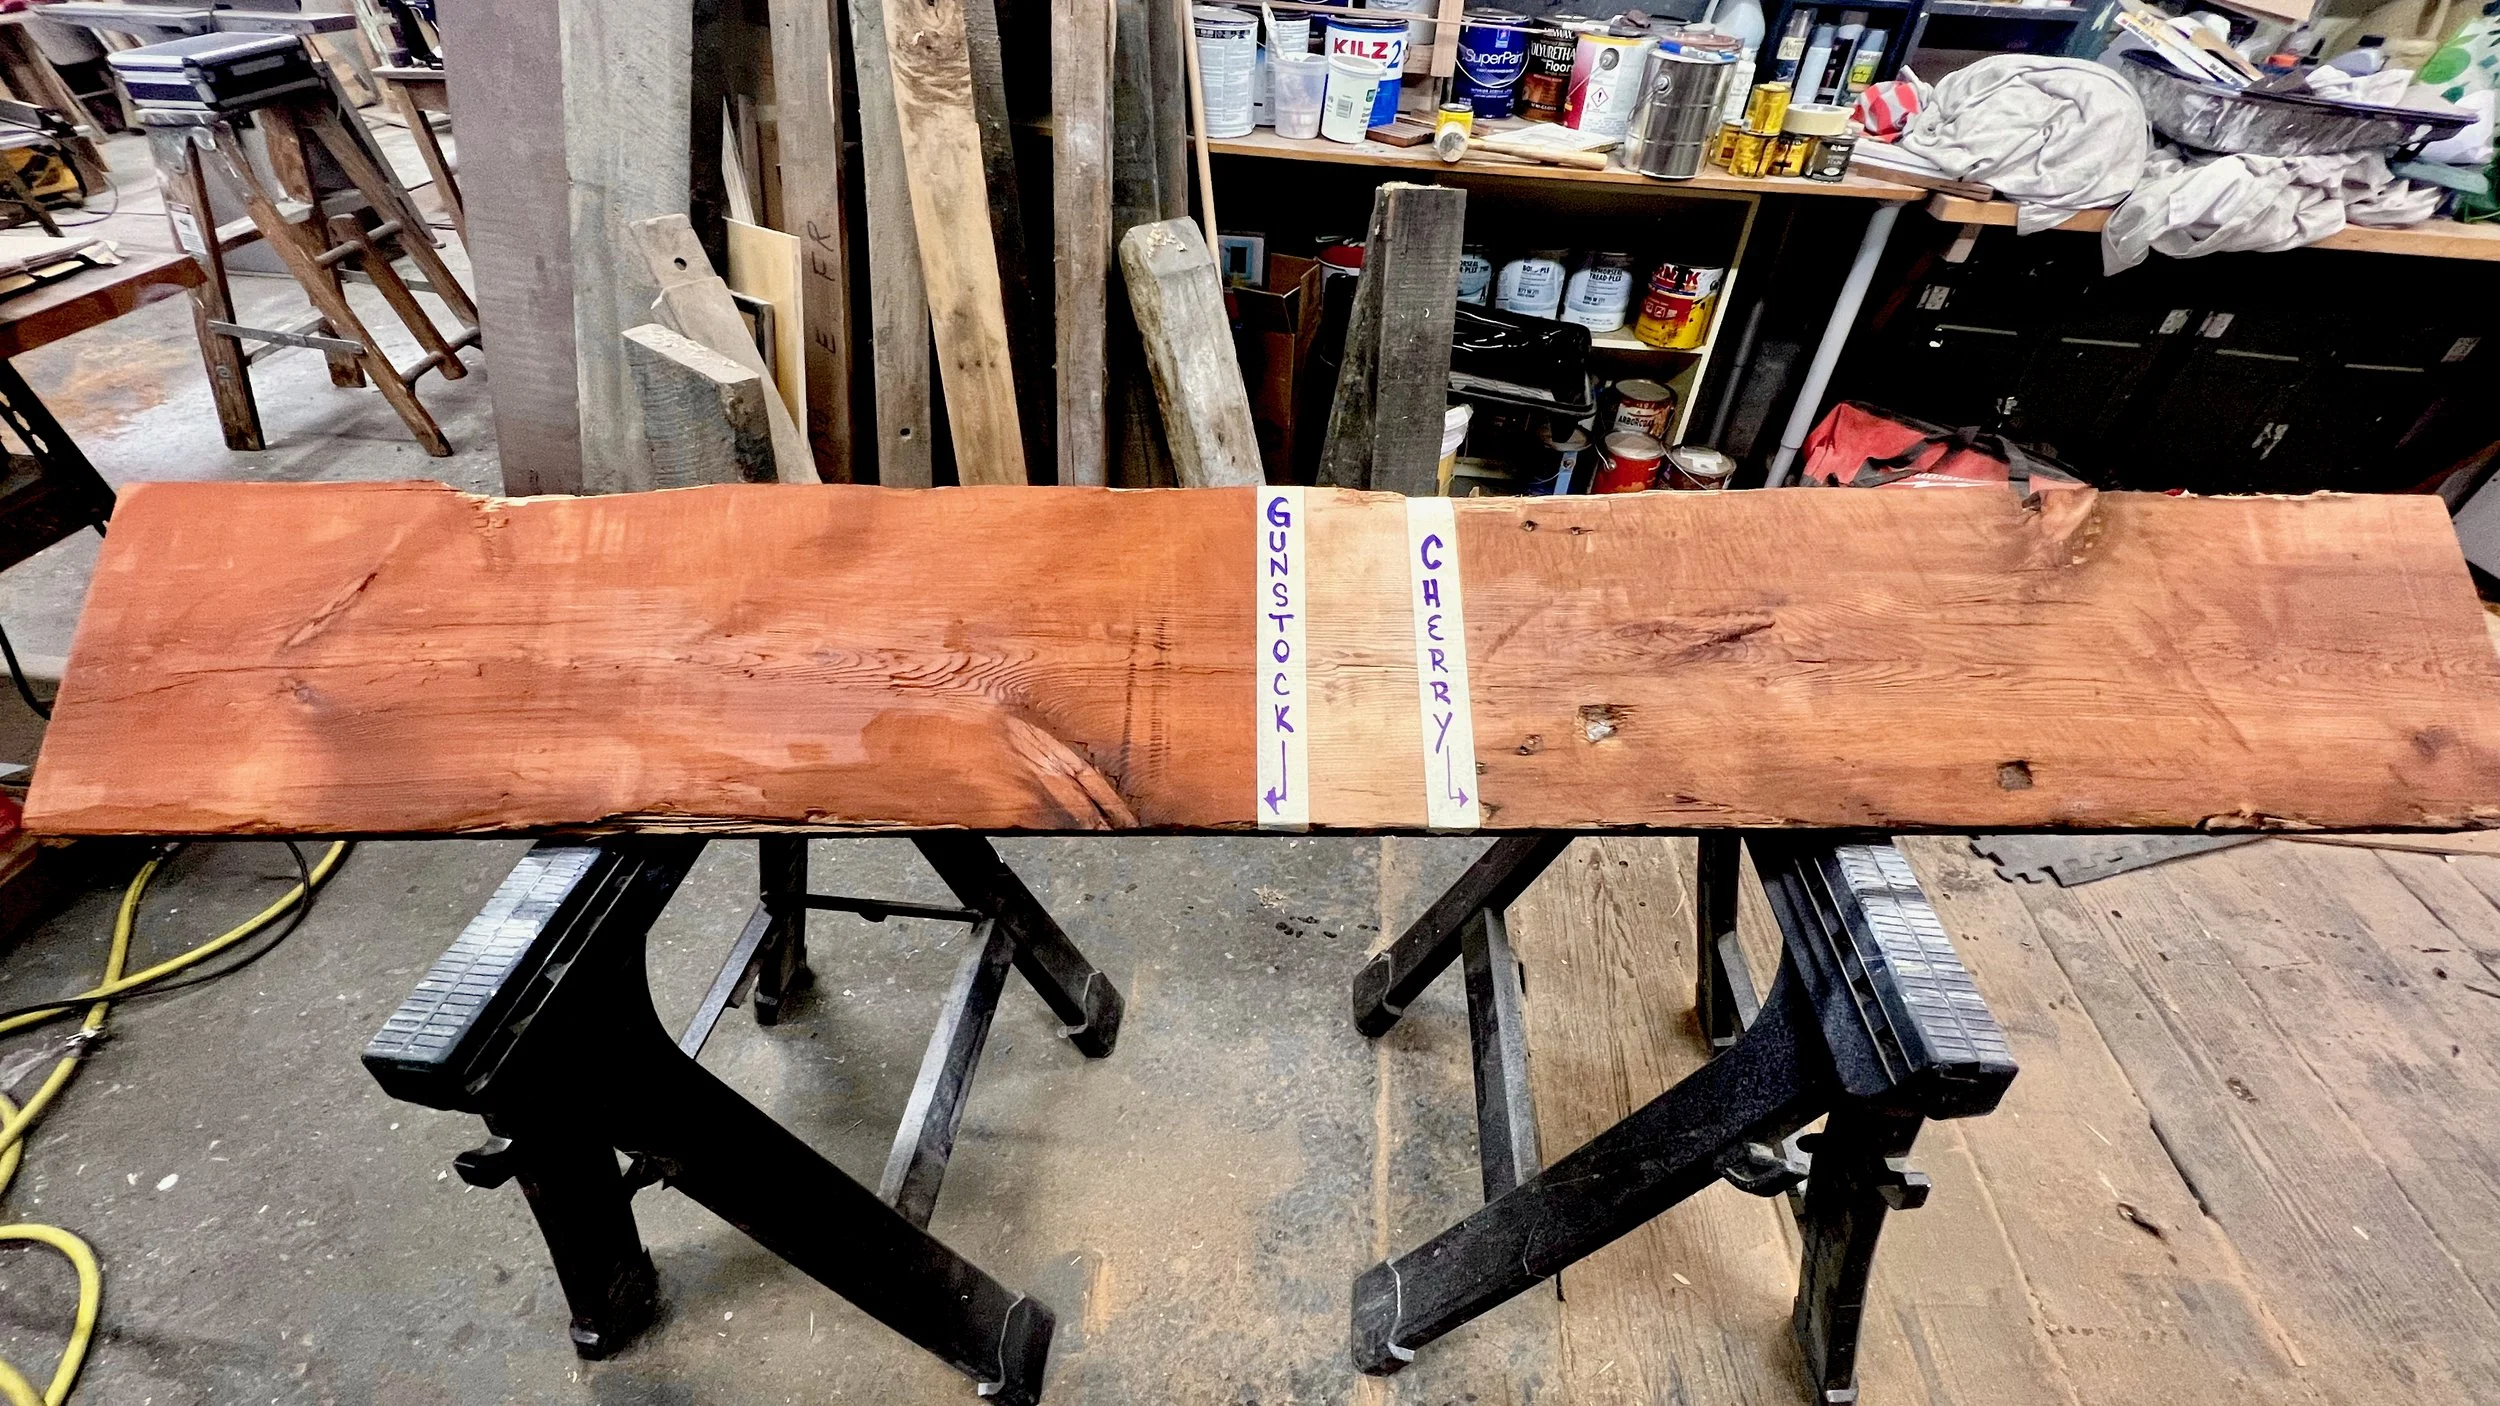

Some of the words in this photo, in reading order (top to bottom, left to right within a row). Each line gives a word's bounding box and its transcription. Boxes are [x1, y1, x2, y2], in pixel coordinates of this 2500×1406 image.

[1333, 37, 1389, 59] KILZ
[1387, 40, 1402, 69] 2
[1531, 42, 1576, 61] OLYURETHA
[1545, 59, 1573, 73] Floor
[1266, 496, 1295, 734] GUNSTOCK
[1420, 533, 1454, 755] CHERRY
